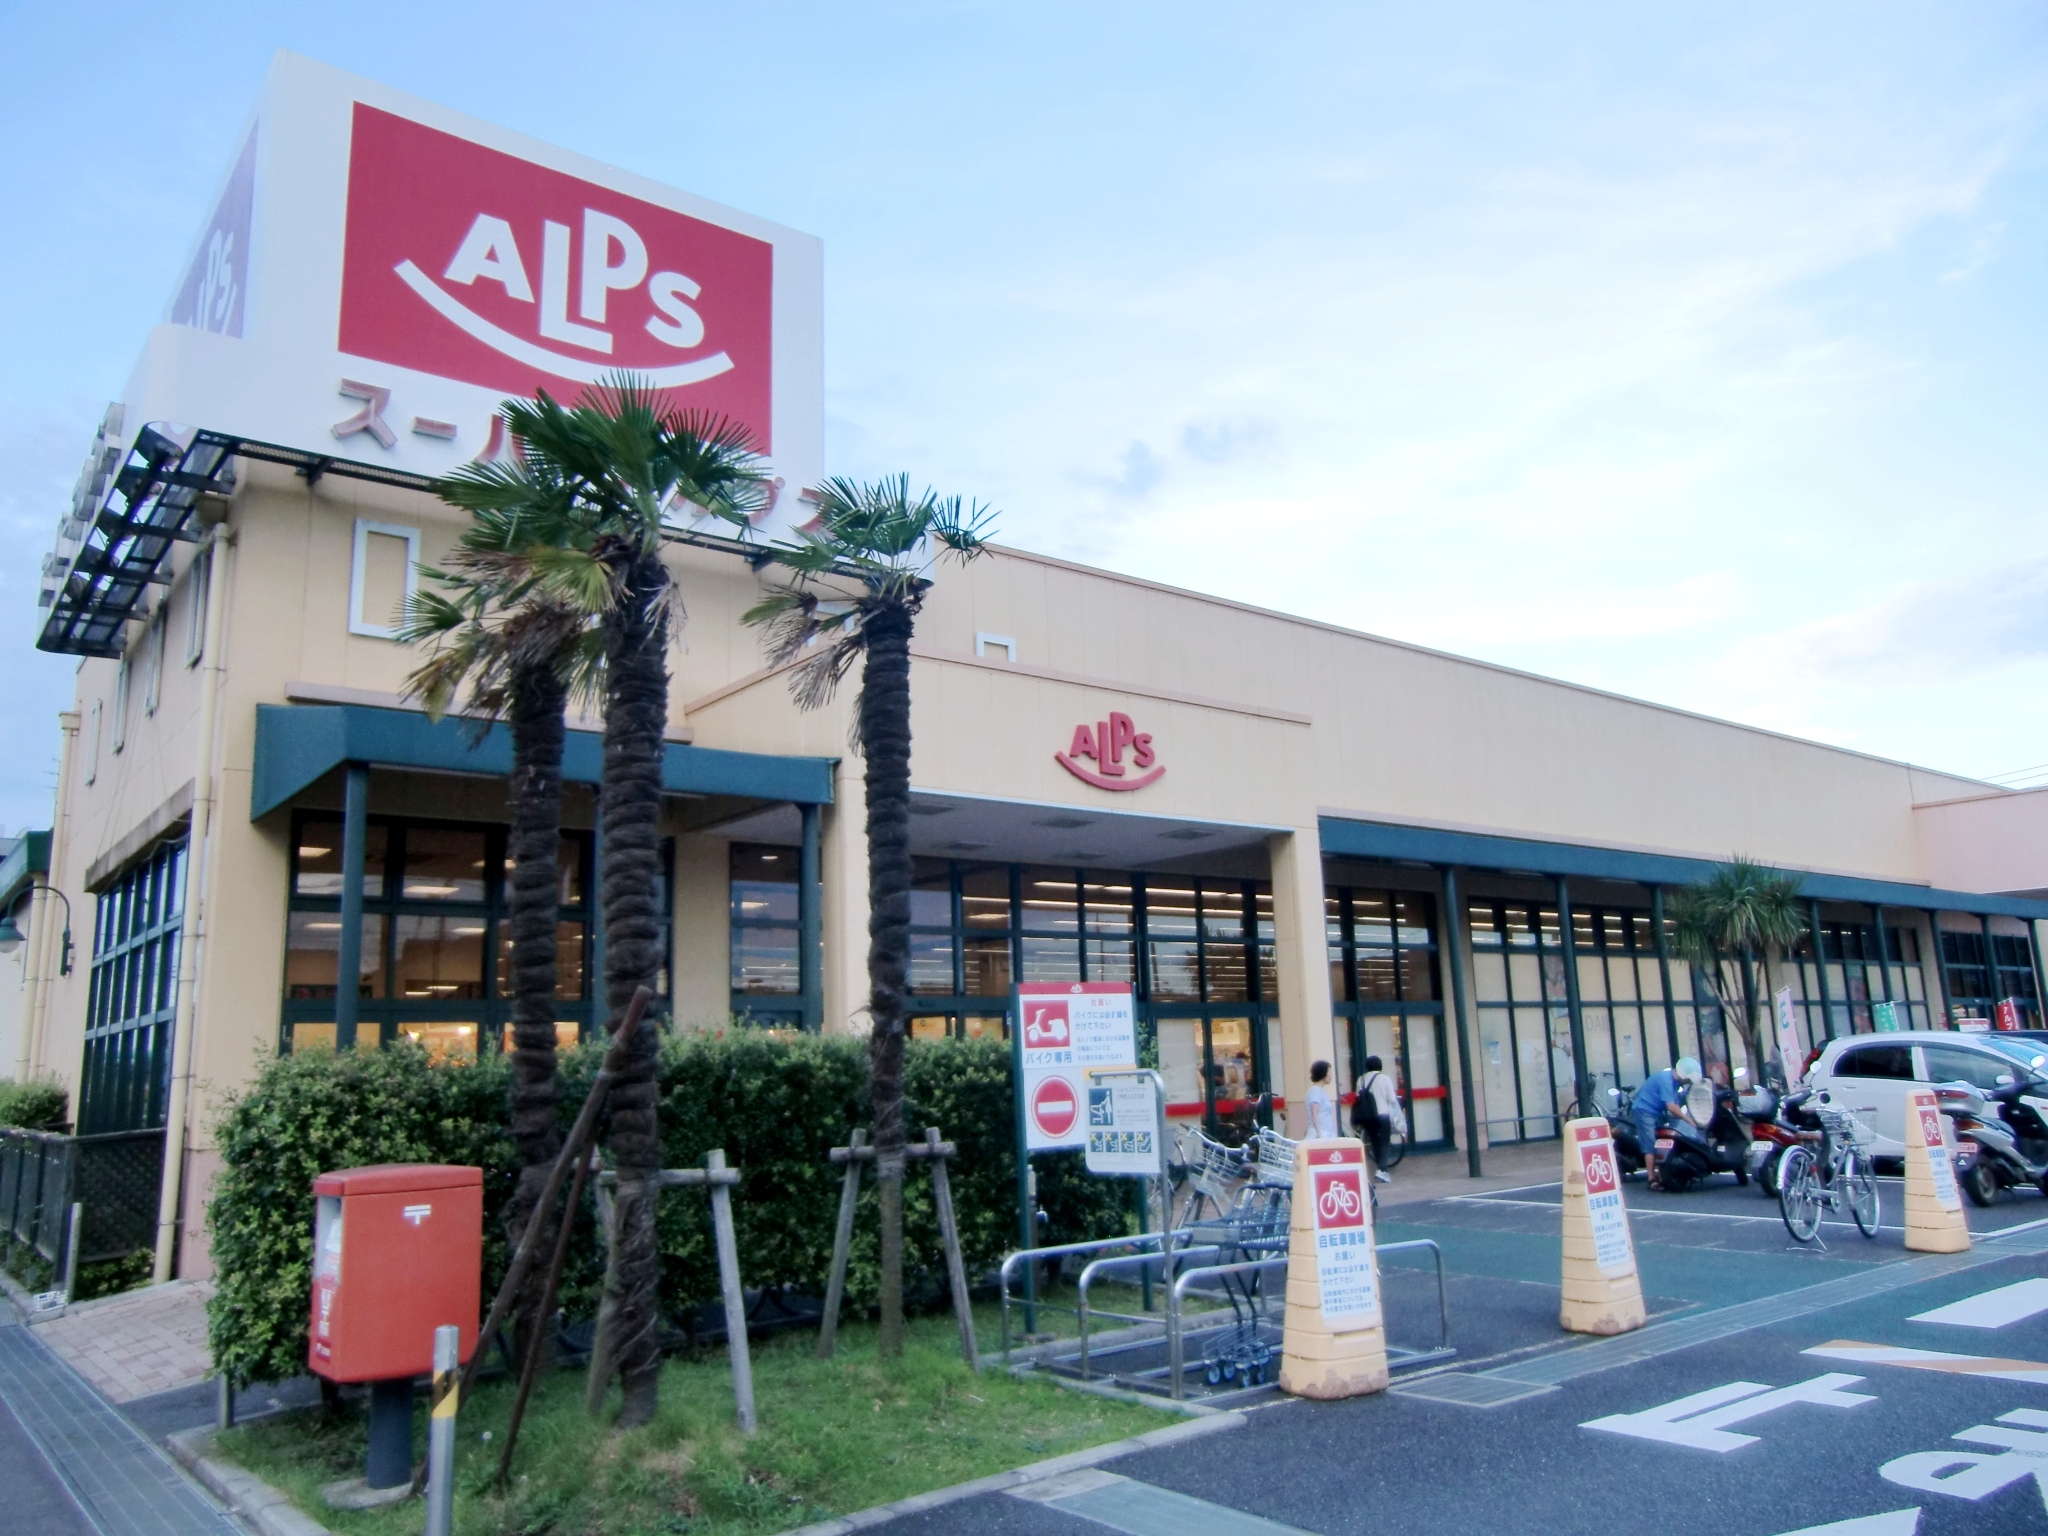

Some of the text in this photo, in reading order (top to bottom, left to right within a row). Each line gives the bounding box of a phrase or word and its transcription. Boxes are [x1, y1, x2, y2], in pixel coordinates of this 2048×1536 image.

[444, 208, 705, 354] ALPS
[1069, 711, 1155, 776] ALPS
[1090, 998, 1112, 1007] お願い
[1075, 1021, 1112, 1030] かけて下さい
[1026, 1051, 1072, 1065] バイク専用
[1319, 1231, 1366, 1249] 自転車置場
